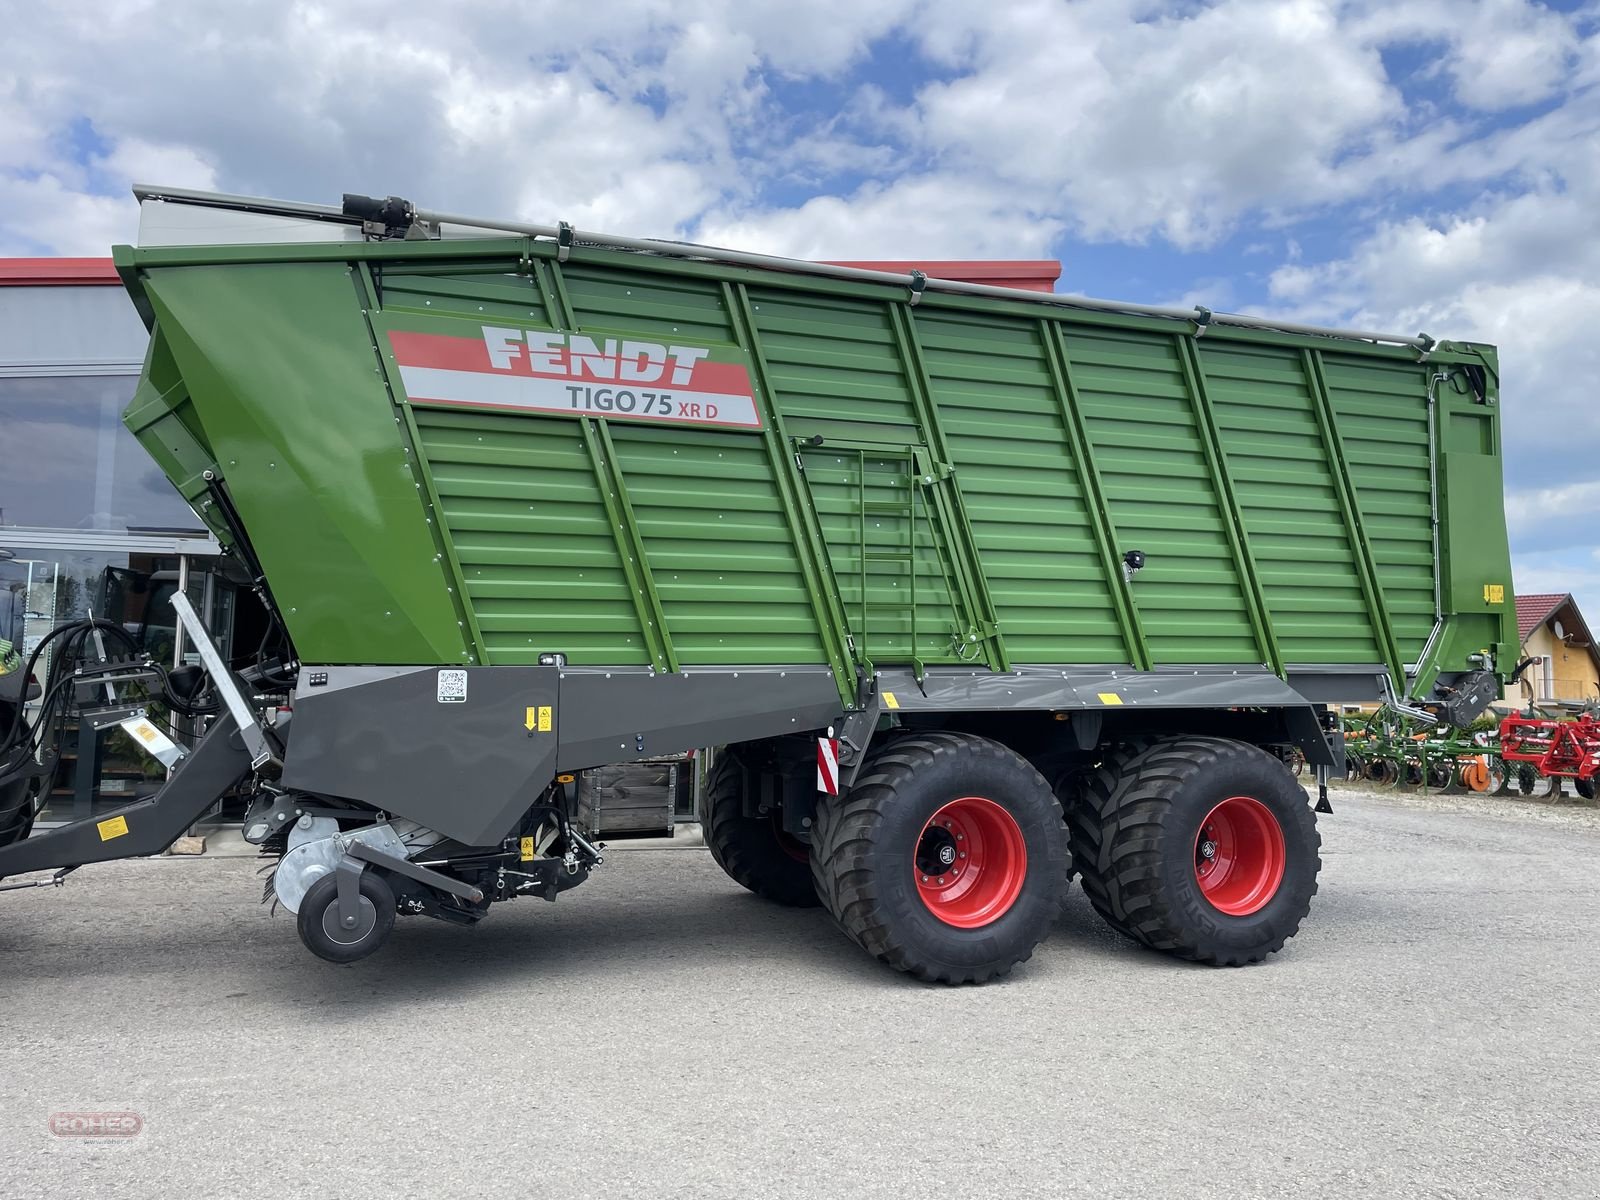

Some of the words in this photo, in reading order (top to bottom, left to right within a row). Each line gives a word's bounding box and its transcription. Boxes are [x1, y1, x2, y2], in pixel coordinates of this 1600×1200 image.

[481, 325, 710, 386] FENDT
[565, 386, 636, 411] TIGO
[642, 393, 673, 415] 75
[677, 401, 701, 418] XR
[705, 404, 719, 419] D
